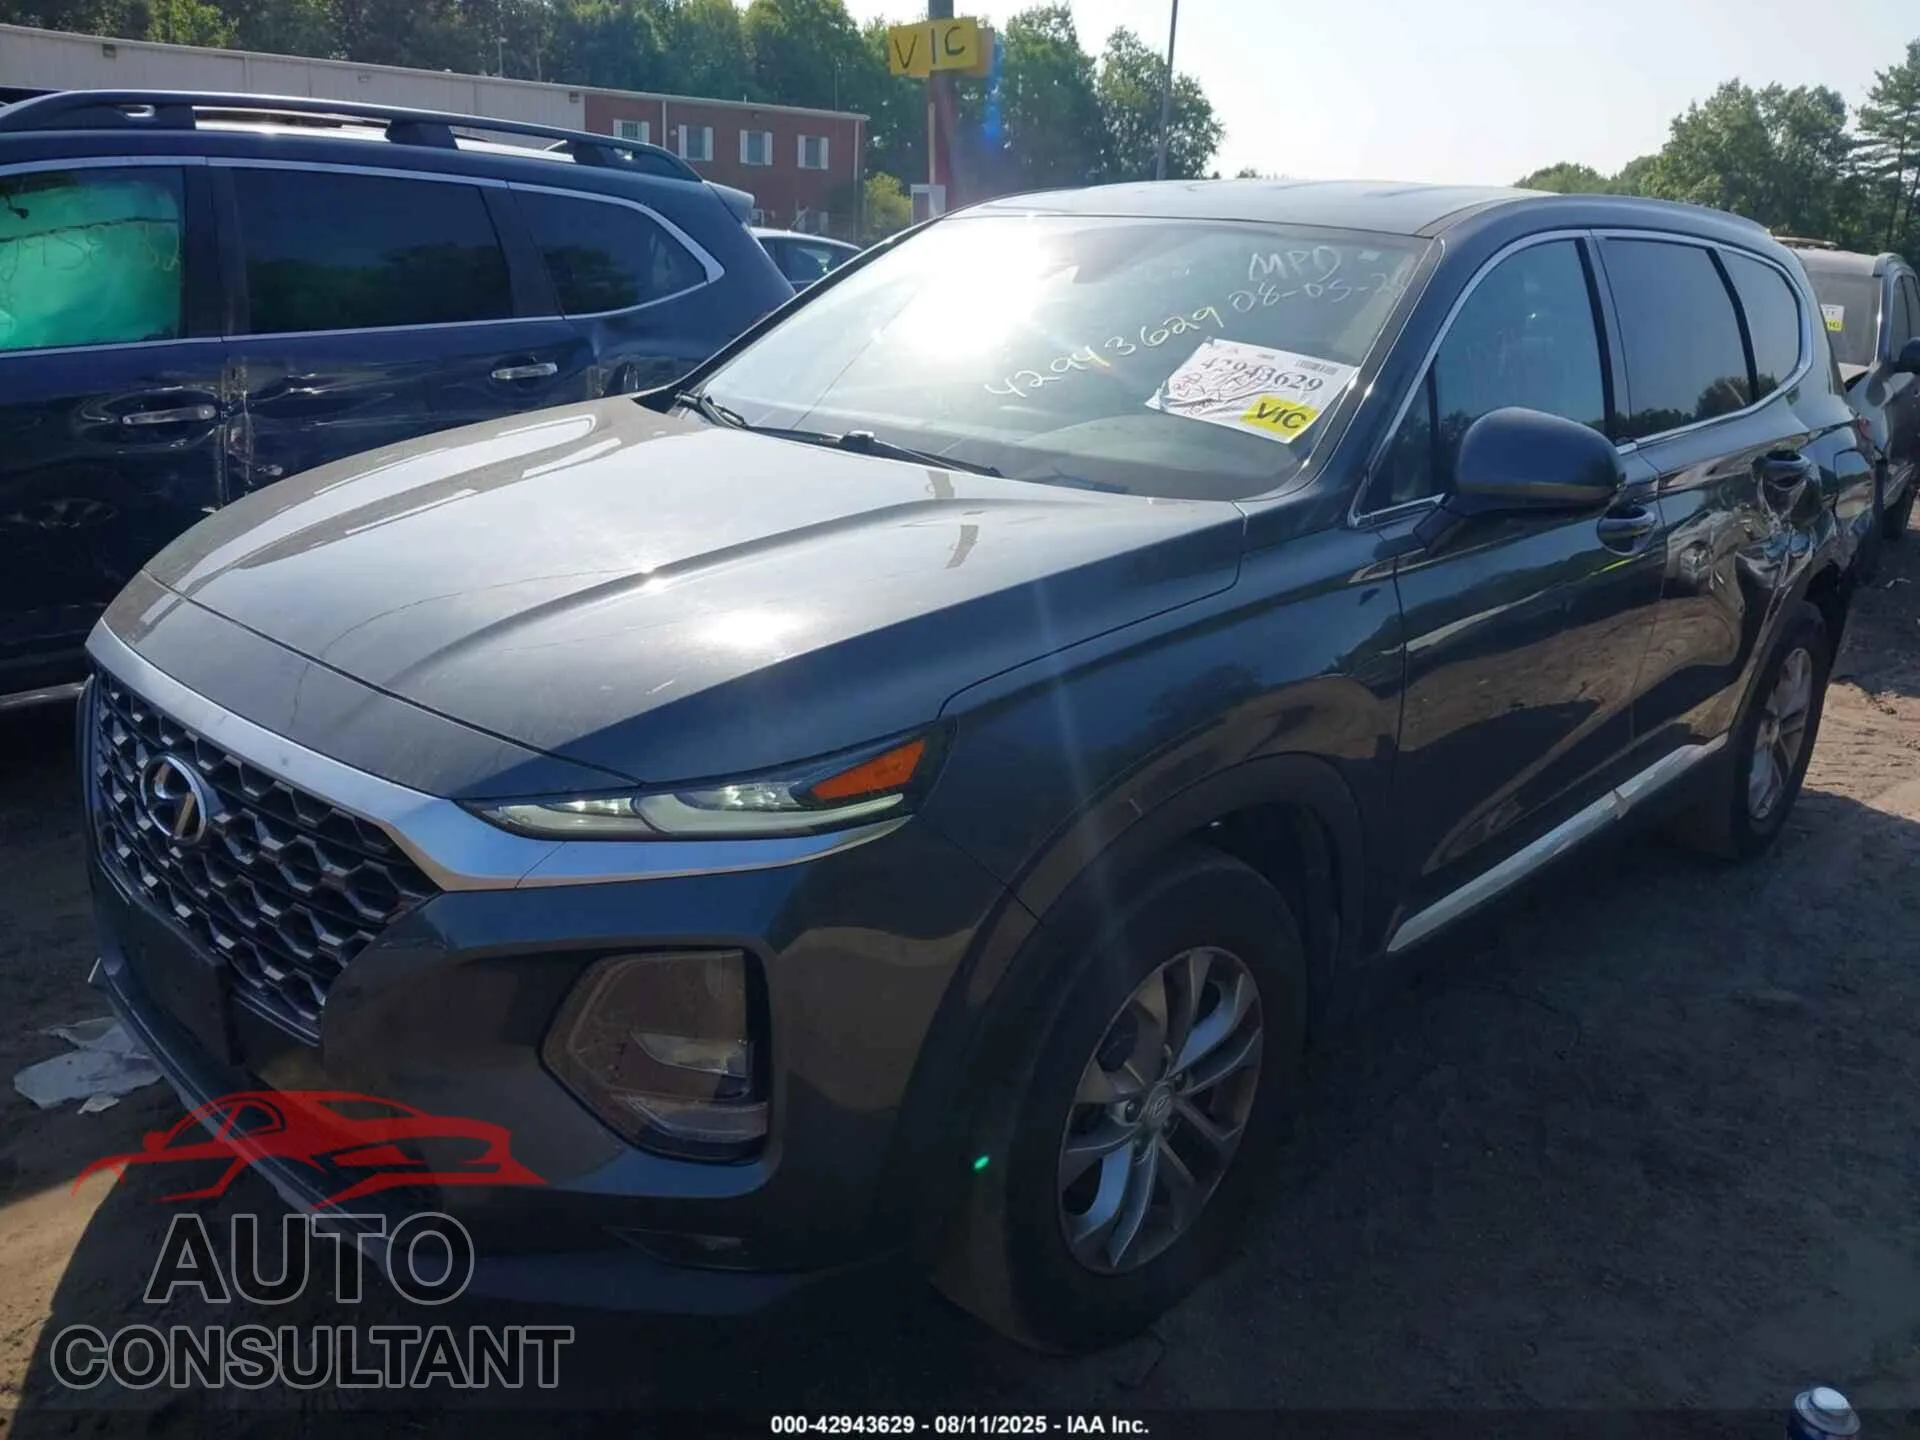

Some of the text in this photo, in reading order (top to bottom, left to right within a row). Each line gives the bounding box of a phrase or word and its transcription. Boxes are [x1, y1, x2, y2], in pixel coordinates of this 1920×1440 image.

[894, 26, 966, 69] VIC
[1249, 246, 1342, 282] MPD
[984, 307, 1224, 398] 42943629
[1255, 402, 1307, 429] VIC
